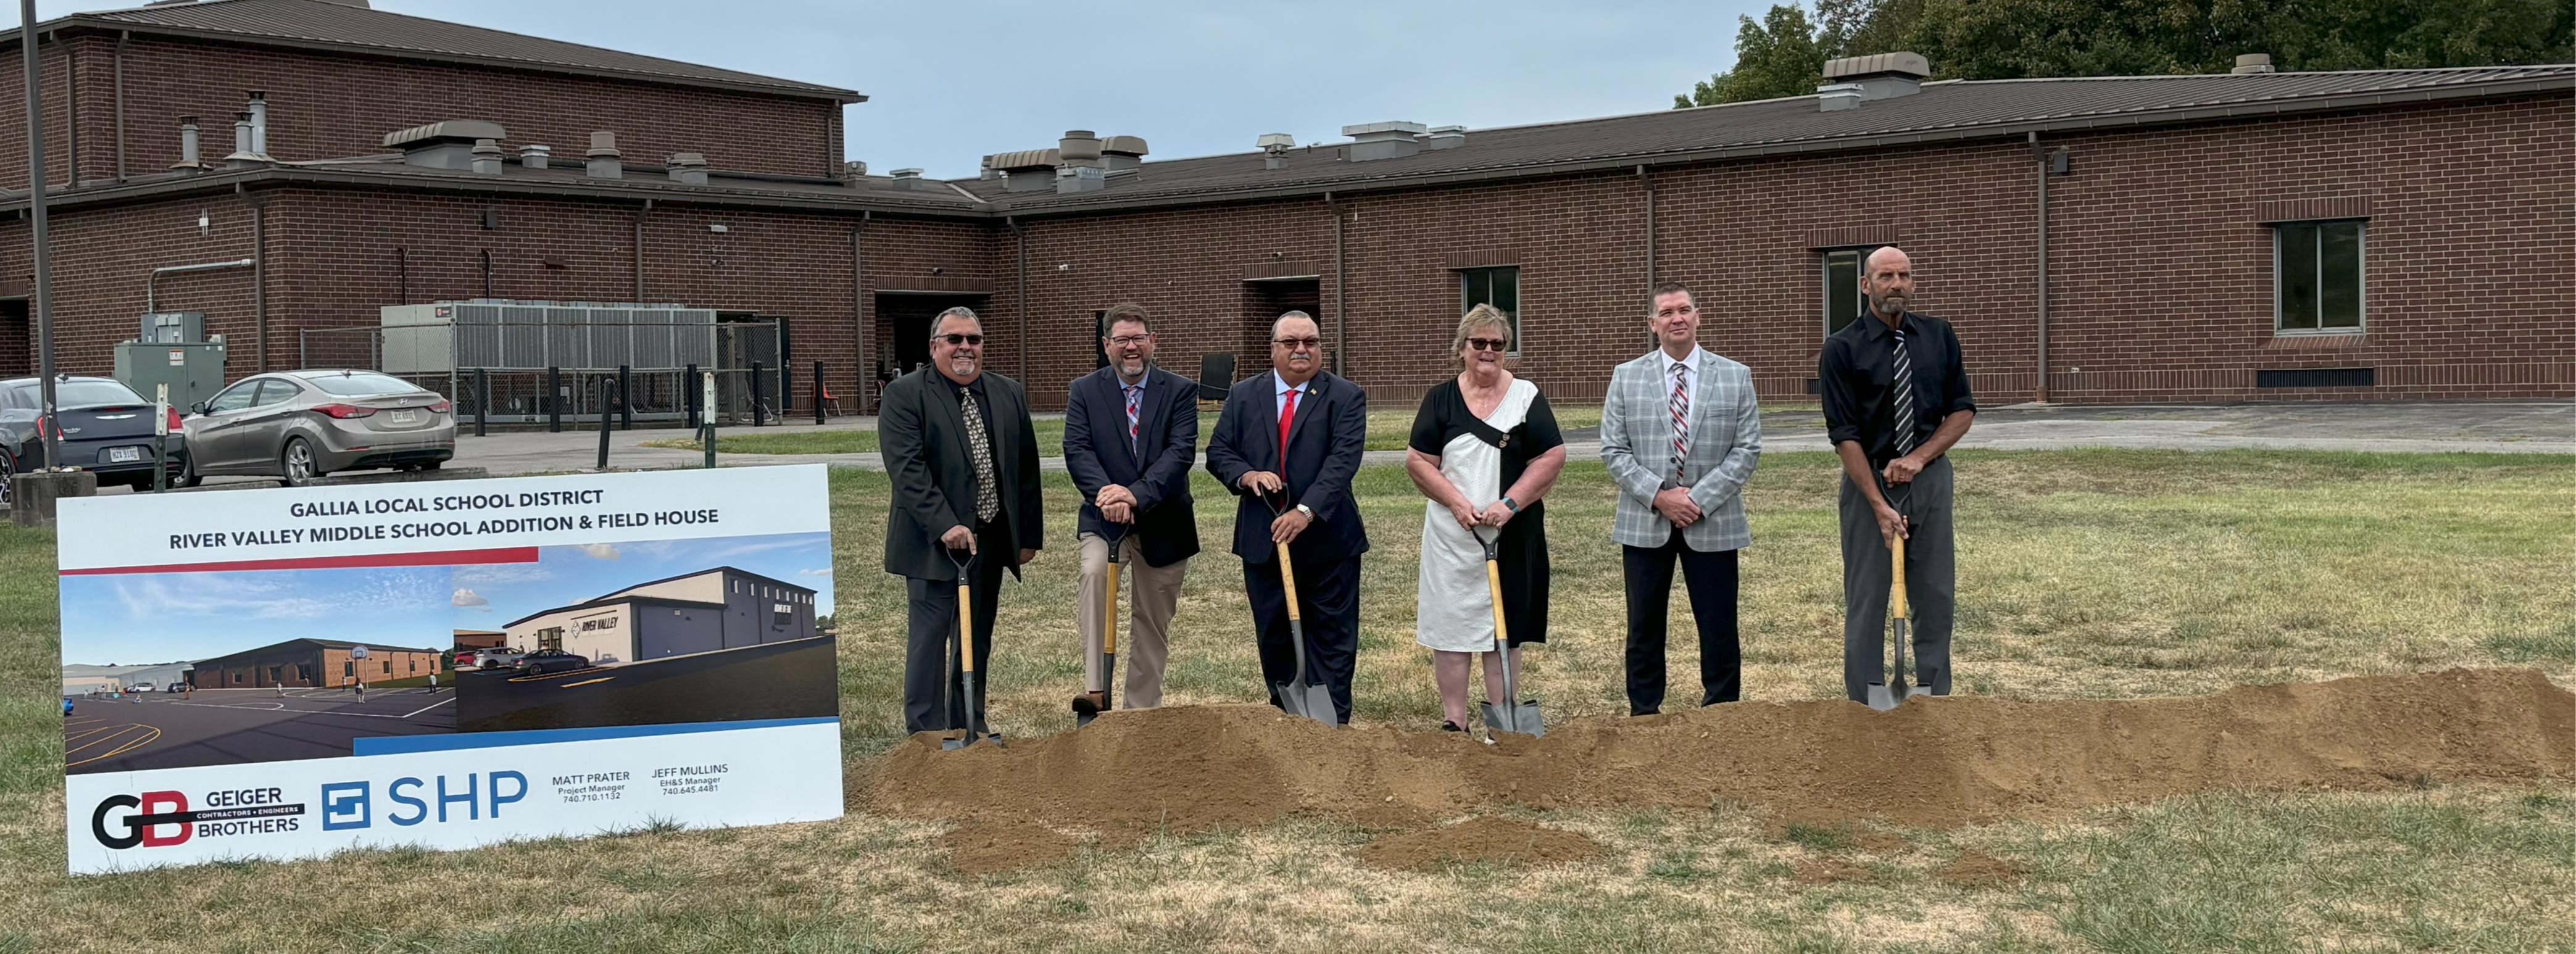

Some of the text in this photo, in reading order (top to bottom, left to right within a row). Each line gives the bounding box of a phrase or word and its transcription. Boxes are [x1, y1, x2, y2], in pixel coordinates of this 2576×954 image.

[291, 490, 603, 517] GALLIA LOCAL SCHOOL DISTRICT
[171, 510, 718, 549] RIVER VALLEY MIDDLE SCHOOL ADDITION & FIELD HOUSE
[583, 617, 618, 631] RIVER VALLEY
[652, 764, 728, 778] JEFF MULLINS
[553, 772, 629, 785] MATT PRATER
[564, 792, 620, 802] 740.710.1132
[663, 785, 717, 795] 740.645.4481
[207, 788, 281, 807] GEIGER
[389, 771, 528, 826] SHP
[196, 810, 251, 818] CONTRACTORS
[199, 818, 298, 837] BROTHERS
